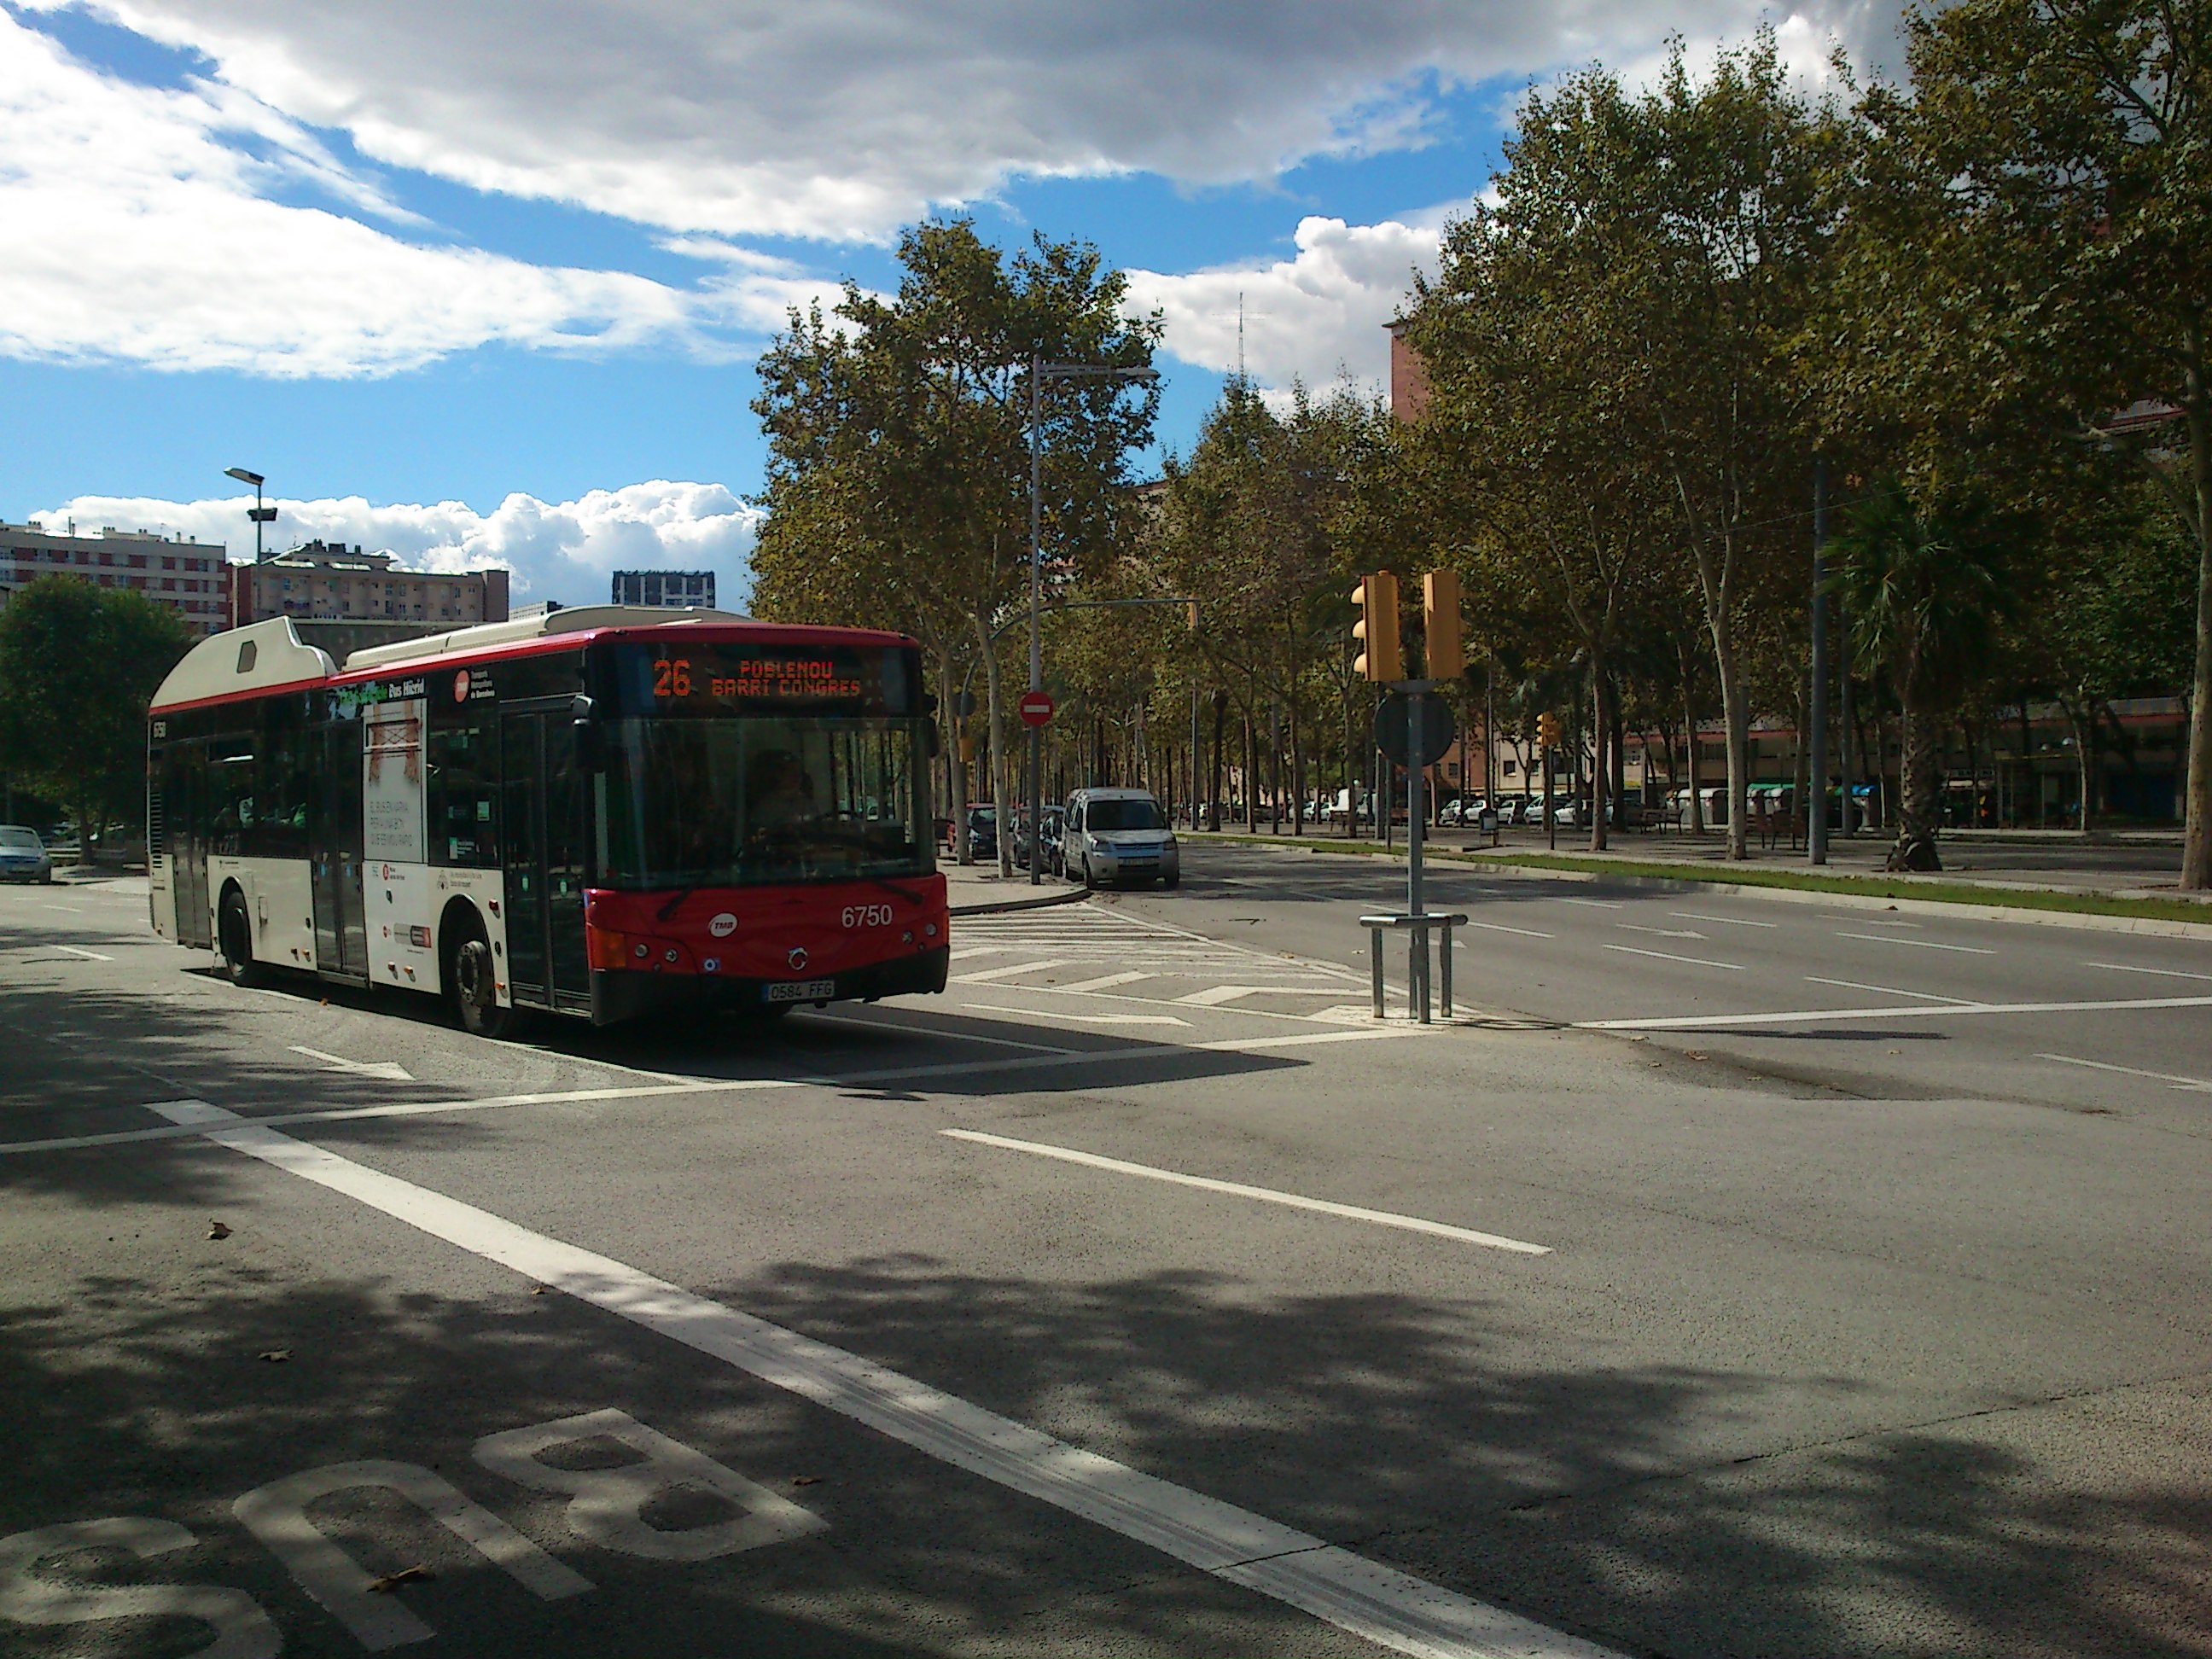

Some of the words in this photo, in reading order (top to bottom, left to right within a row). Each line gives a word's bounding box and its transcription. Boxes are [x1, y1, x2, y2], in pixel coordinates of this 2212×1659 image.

[655, 660, 691, 696] 26
[739, 661, 834, 679] POBLENOU
[712, 678, 770, 696] BARRI
[780, 678, 861, 696] CONGRES
[841, 905, 893, 928] 6750
[771, 985, 802, 998] 0584
[809, 982, 832, 996] FFG
[0, 1406, 831, 1659] BUS
